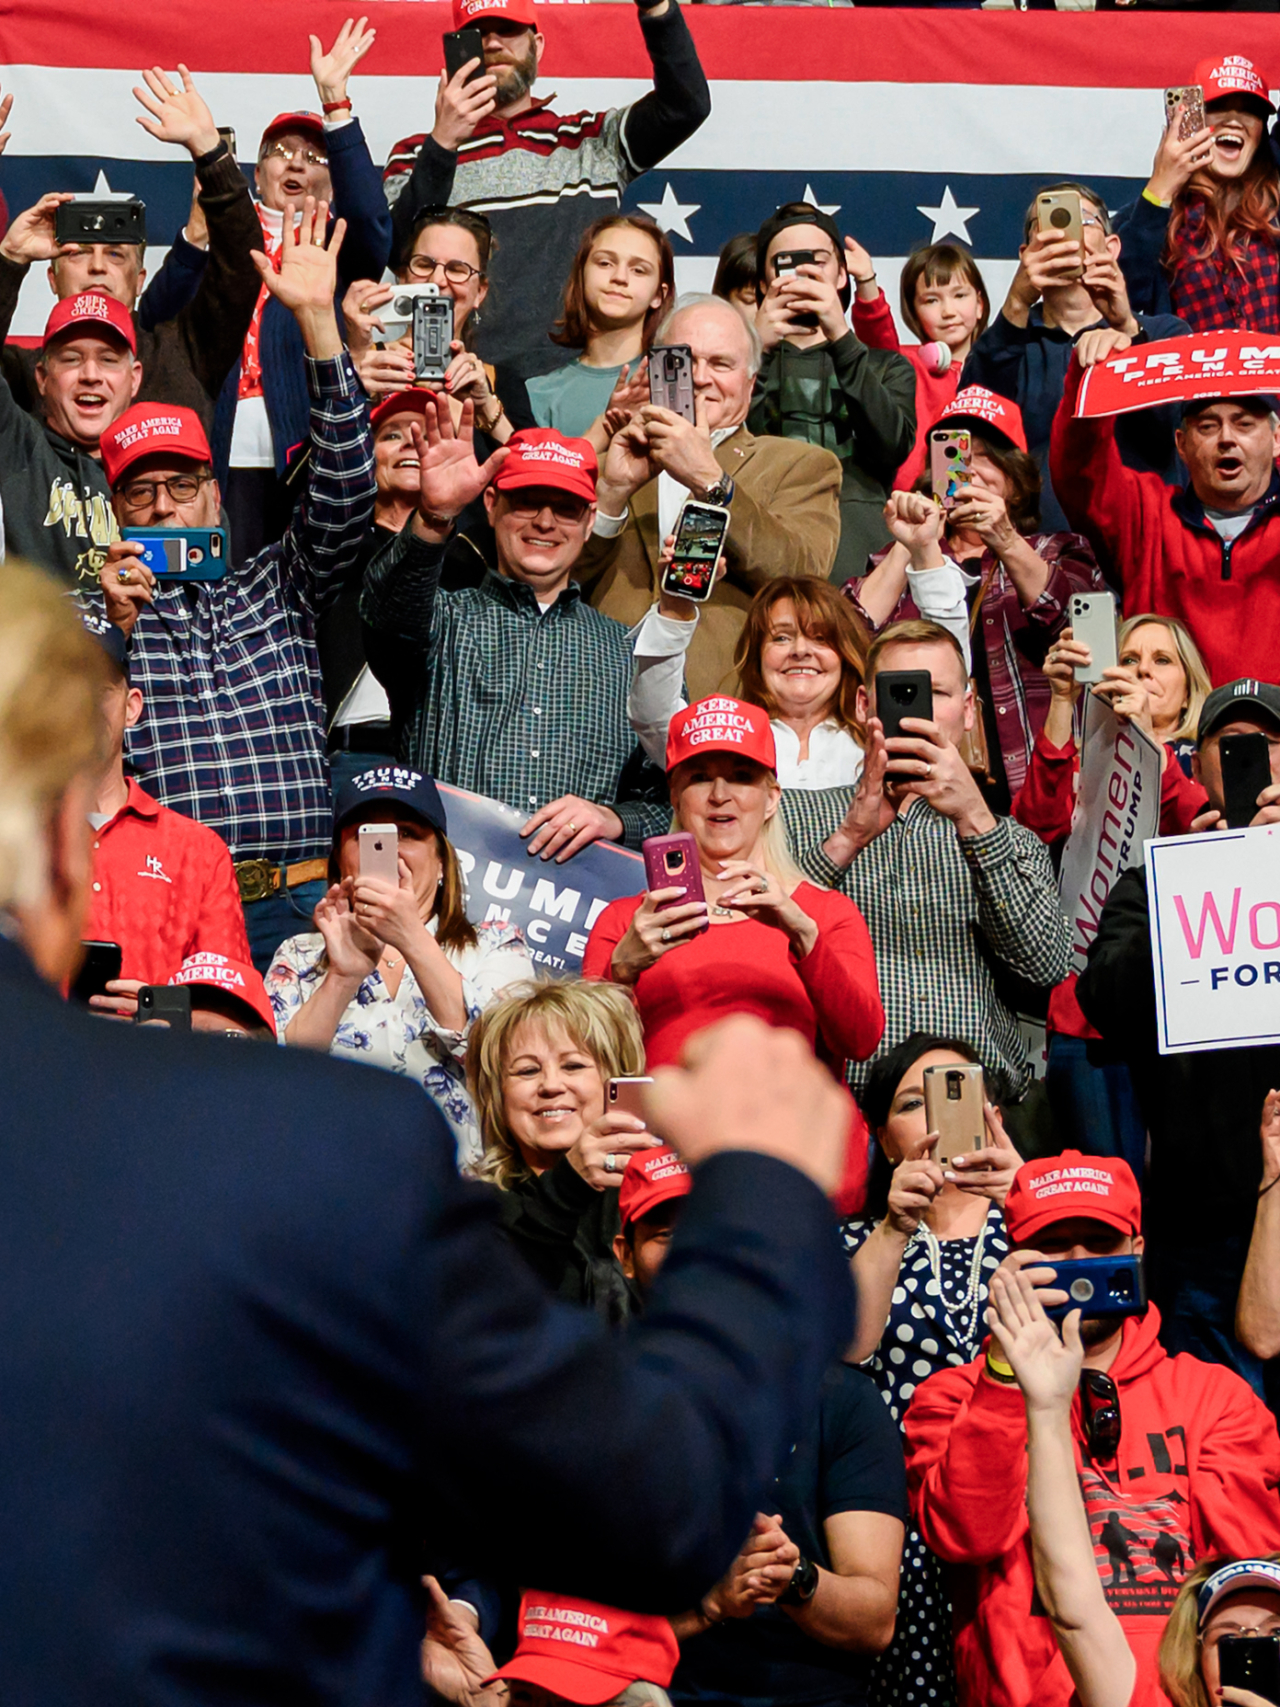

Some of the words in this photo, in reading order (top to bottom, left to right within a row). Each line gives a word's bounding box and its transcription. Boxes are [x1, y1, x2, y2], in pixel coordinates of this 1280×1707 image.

[467, 0, 508, 15] GREAT
[1223, 55, 1253, 70] KEEP
[1209, 66, 1263, 89] AMERICA
[1217, 77, 1258, 91] GREAT
[1106, 346, 1280, 374] TRUM
[1123, 360, 1265, 382] PENC
[1137, 376, 1170, 387] KEEP
[1174, 371, 1234, 381] AMERICA
[1238, 368, 1280, 376] GREAT
[956, 386, 993, 400] KEEP
[1193, 391, 1221, 399] 2020
[941, 397, 1005, 416] AMERICA
[114, 423, 138, 445] MAKE
[140, 417, 183, 430] AMERICA
[121, 428, 149, 450] GREAT
[152, 425, 180, 436] AGAIN
[522, 451, 551, 461] GREAT
[552, 453, 581, 468] AGAIN
[544, 441, 585, 461] AMERICA
[696, 698, 738, 715] KEEP
[681, 713, 754, 737] AMERICA
[690, 728, 744, 745] GREAT
[351, 767, 423, 784] TRUMP
[1116, 770, 1143, 878] TRUMP
[1073, 731, 1135, 957] Women
[455, 848, 611, 931] RUM
[181, 951, 228, 970] KEEP
[528, 948, 565, 970] REAT!
[167, 965, 245, 986] AMERICA
[1211, 961, 1280, 990] FOR
[644, 1153, 678, 1172] MAKE
[1029, 1169, 1061, 1189] MAKE
[1061, 1167, 1114, 1185] AMERICA
[1036, 1182, 1073, 1199] GREAT
[1073, 1181, 1109, 1196] AGAIN
[547, 1607, 609, 1634] AMERICA
[551, 1626, 599, 1648] AGAIN
